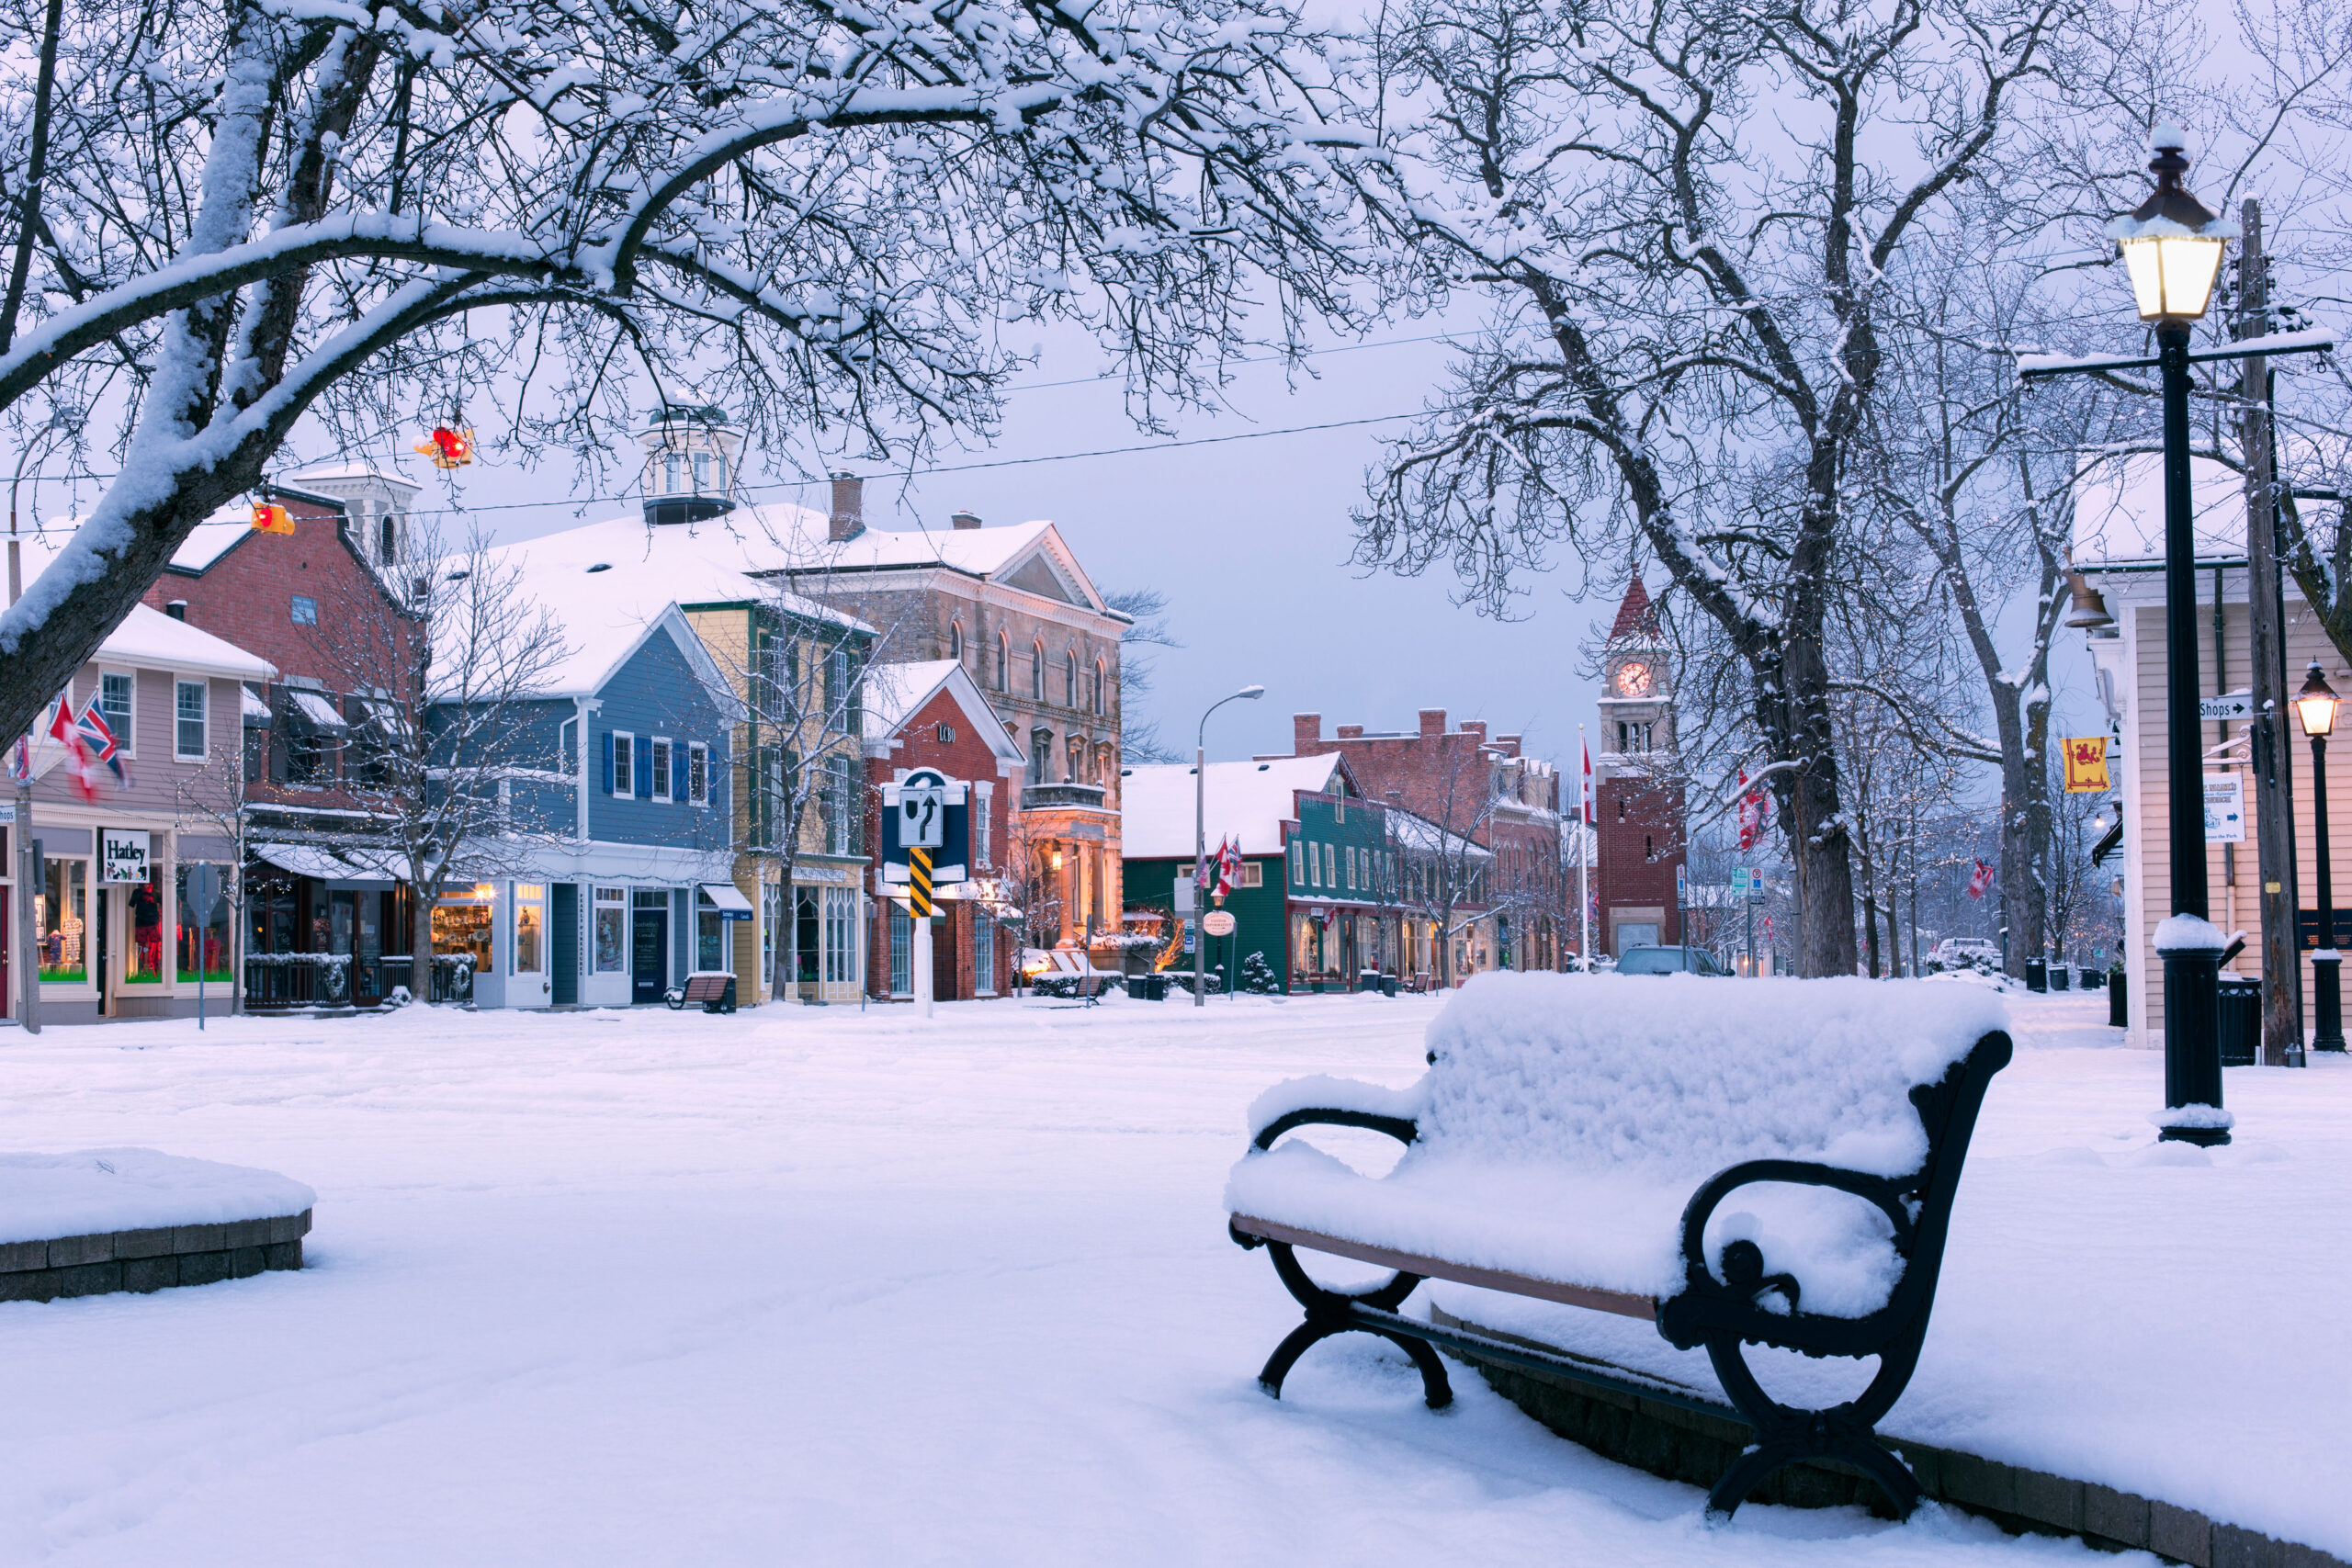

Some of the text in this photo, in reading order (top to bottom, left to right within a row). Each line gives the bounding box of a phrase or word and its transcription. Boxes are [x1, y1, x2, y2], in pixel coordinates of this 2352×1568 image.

[2199, 703, 2230, 718] Shops
[939, 726, 956, 742] LCBO
[107, 840, 145, 864] Hatley
